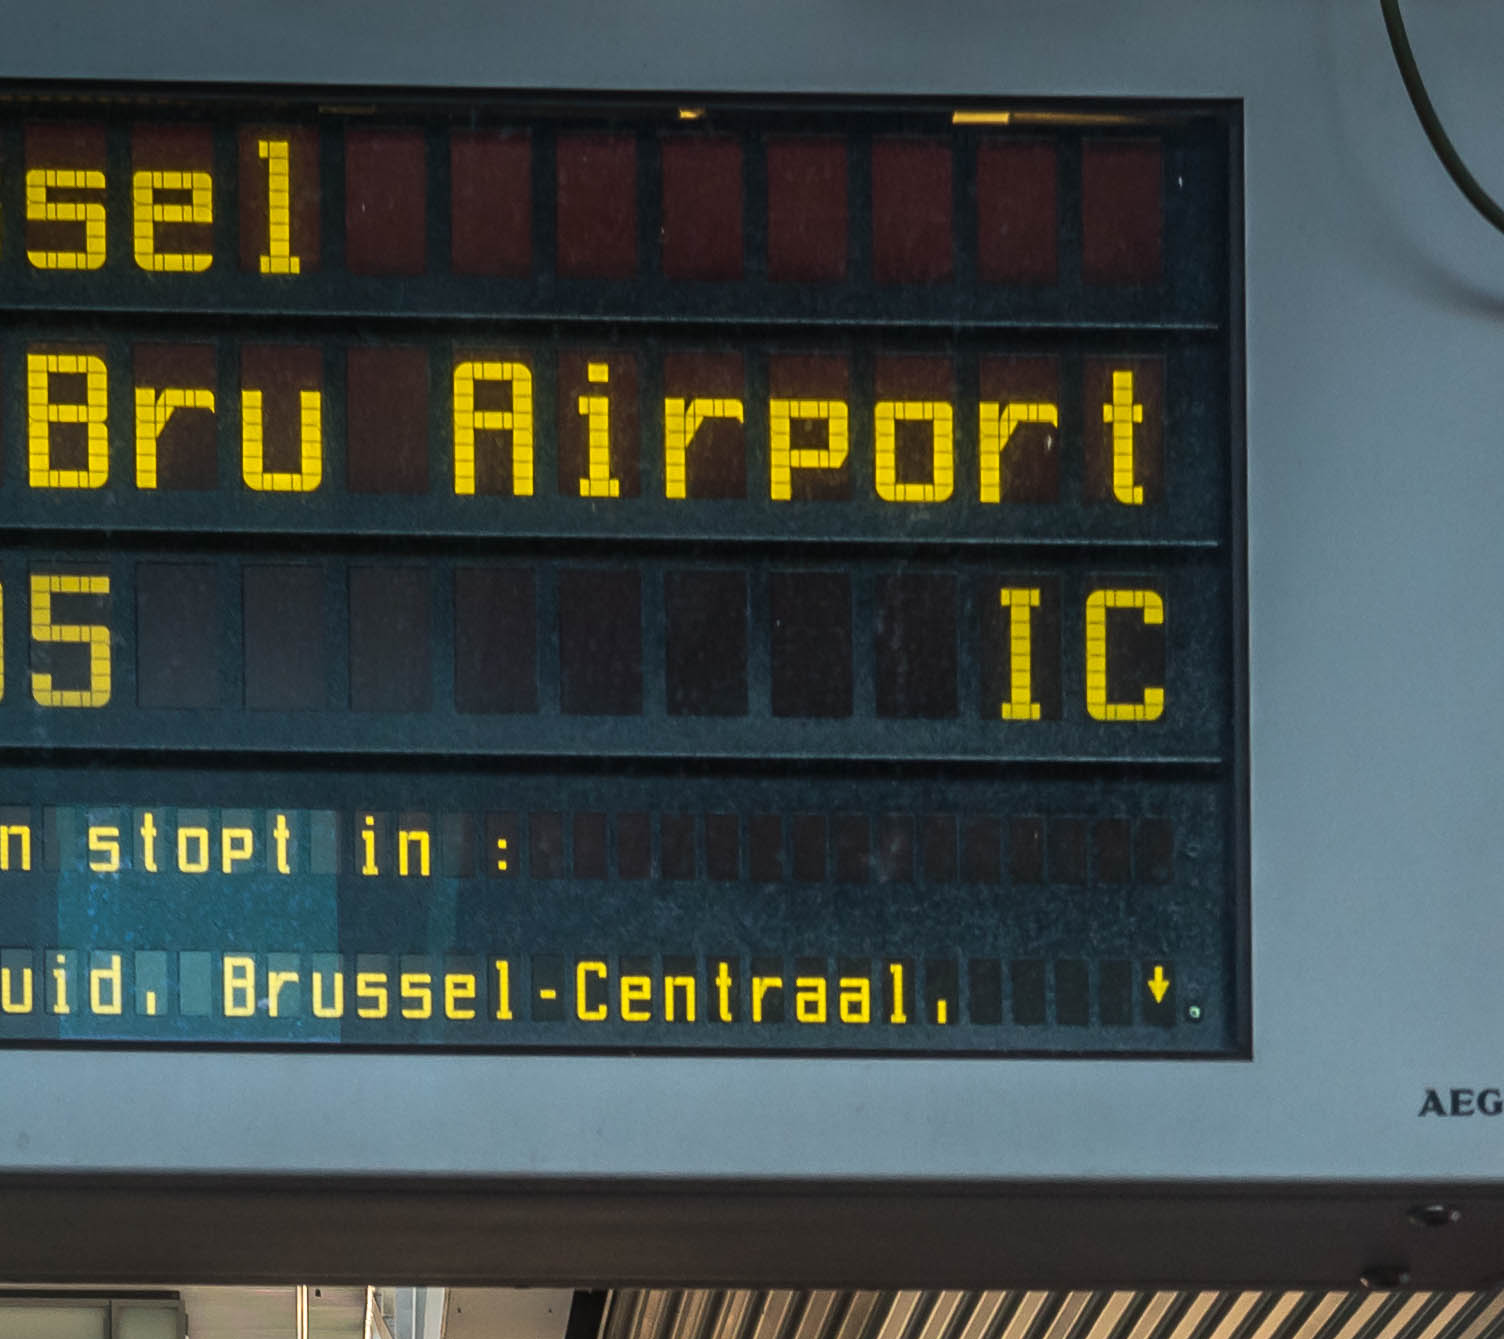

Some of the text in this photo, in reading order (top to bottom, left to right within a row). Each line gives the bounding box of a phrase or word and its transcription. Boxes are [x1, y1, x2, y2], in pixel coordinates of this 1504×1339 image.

[26, 352, 1145, 505] Bru Airport
[999, 587, 1166, 722] IC
[88, 811, 291, 875] stopt
[360, 815, 432, 877] in
[222, 955, 948, 1025] Brussel-Centraal,
[1417, 1088, 1504, 1117] AEG
